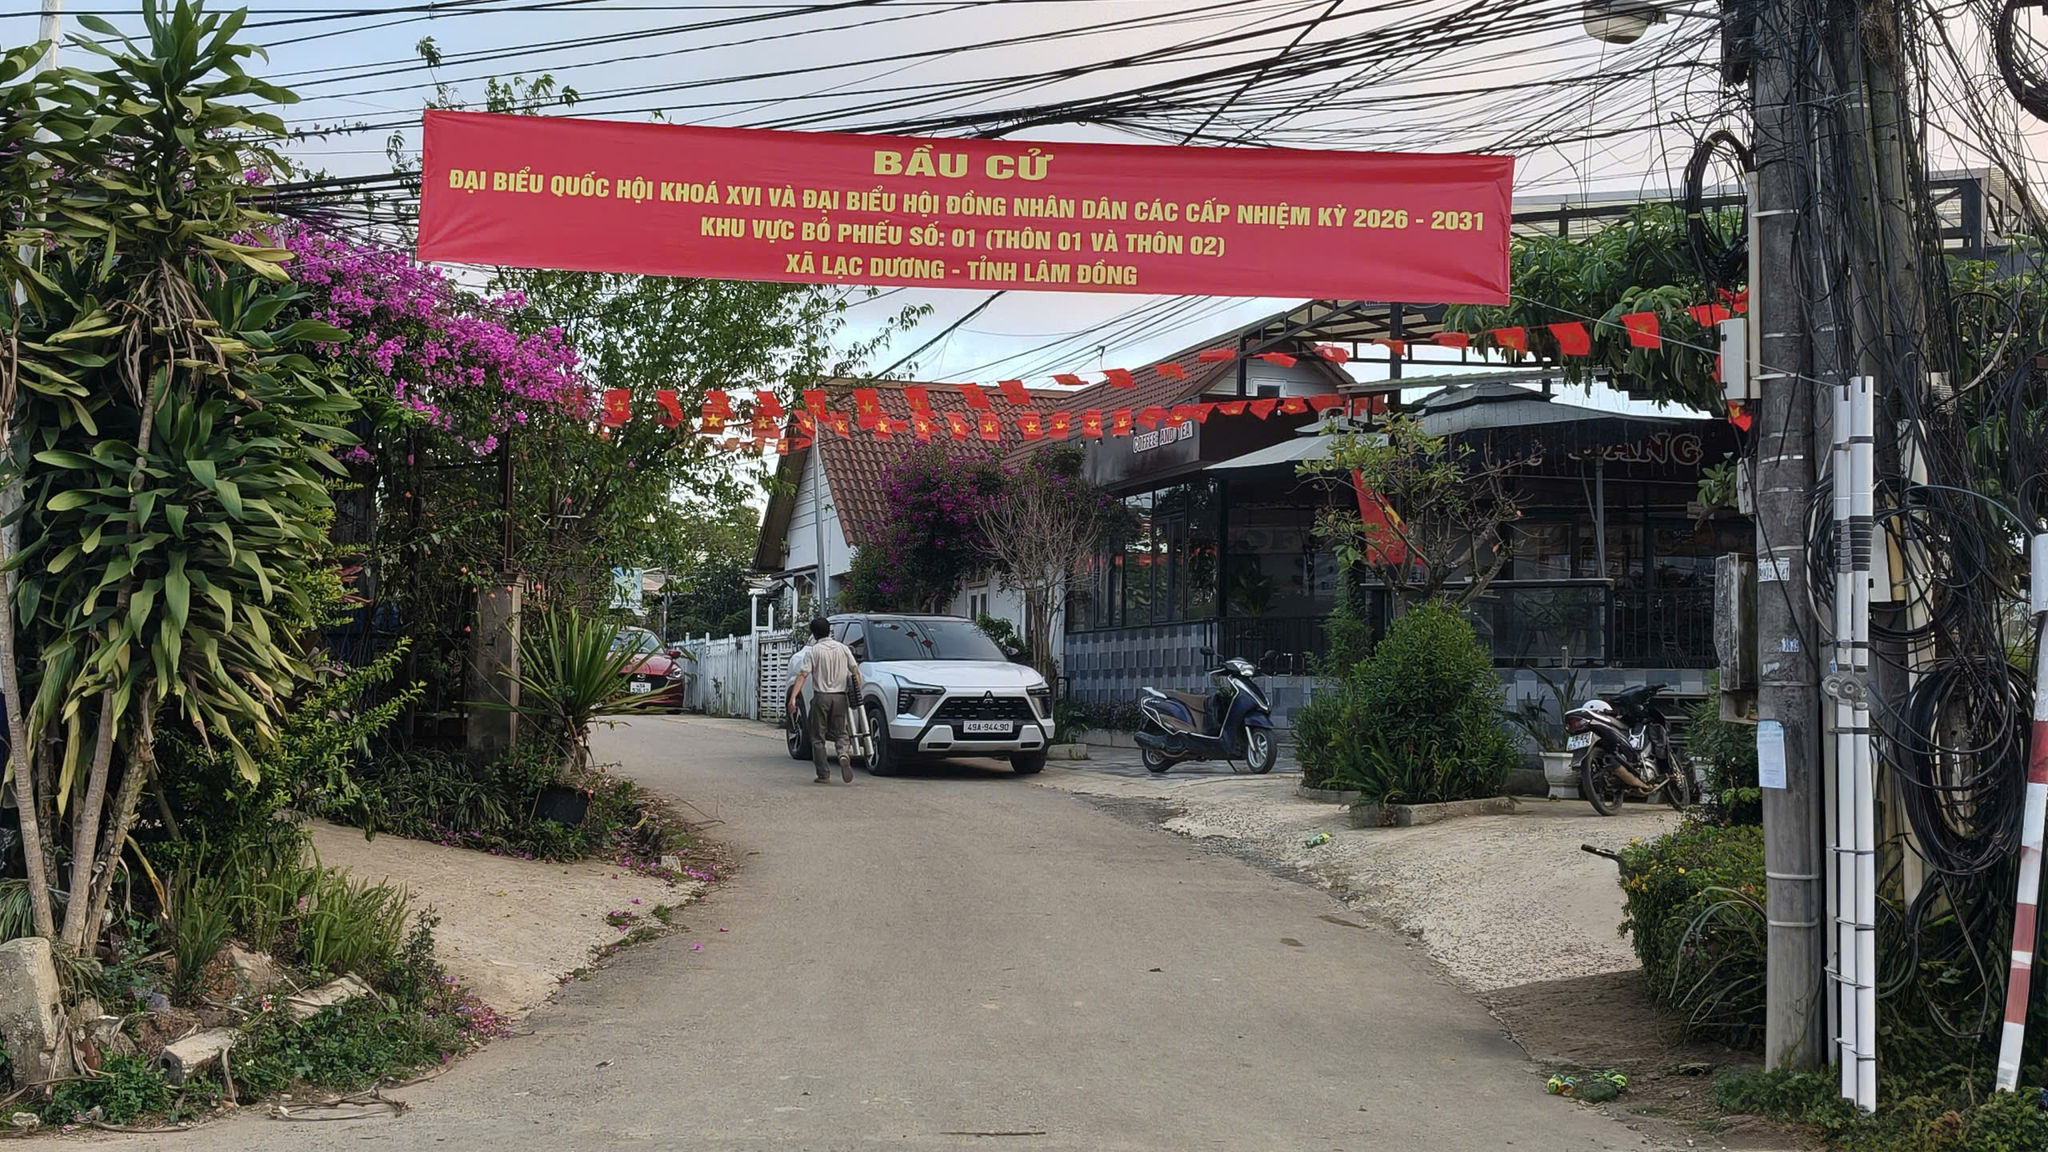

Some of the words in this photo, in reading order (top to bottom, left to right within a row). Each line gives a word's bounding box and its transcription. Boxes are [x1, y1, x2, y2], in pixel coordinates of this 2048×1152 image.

[874, 144, 968, 177] BẦU
[986, 147, 1053, 180] CỬ
[449, 169, 486, 193] ĐẠI
[493, 166, 544, 194] BIỂU
[550, 171, 609, 198] QUỐC
[617, 176, 653, 202] HỘI
[660, 179, 719, 204] KHOÁ
[726, 185, 762, 206] XVI
[768, 185, 796, 207] VÀ
[803, 189, 839, 213] ĐẠI
[847, 185, 896, 212] BIỂU
[903, 192, 939, 217] HỘI
[946, 193, 1006, 216] ĐỒNG
[1013, 195, 1075, 219] NHÂN
[1082, 197, 1127, 221] DÂN
[1134, 199, 1178, 222] CÁC
[1186, 198, 1230, 223] CẤP
[1237, 204, 1311, 228] NHIỆM
[1318, 204, 1346, 228] KỲ
[1353, 209, 1408, 229] 2026
[1431, 210, 1485, 232] 2031
[701, 217, 745, 238] KHU
[753, 218, 794, 242] VỰC
[801, 216, 831, 242] BỎ
[838, 218, 903, 246] PHIẾU
[909, 222, 946, 247] SỐ:
[952, 229, 975, 247] 01
[986, 227, 1051, 251] (THÔN
[1057, 232, 1081, 251] 01
[1090, 230, 1118, 252] VÀ
[1126, 231, 1183, 254] THÔN
[1190, 236, 1225, 257] 02)
[786, 252, 815, 273] XÃ
[822, 255, 862, 279] LẠC
[870, 256, 944, 279] DƯƠNG
[968, 255, 1017, 282] TỈNH
[1024, 259, 1071, 283] LÂM
[1077, 259, 1137, 286] ĐỒNG
[1132, 430, 1159, 453] COFFEE
[1160, 426, 1177, 446] AND
